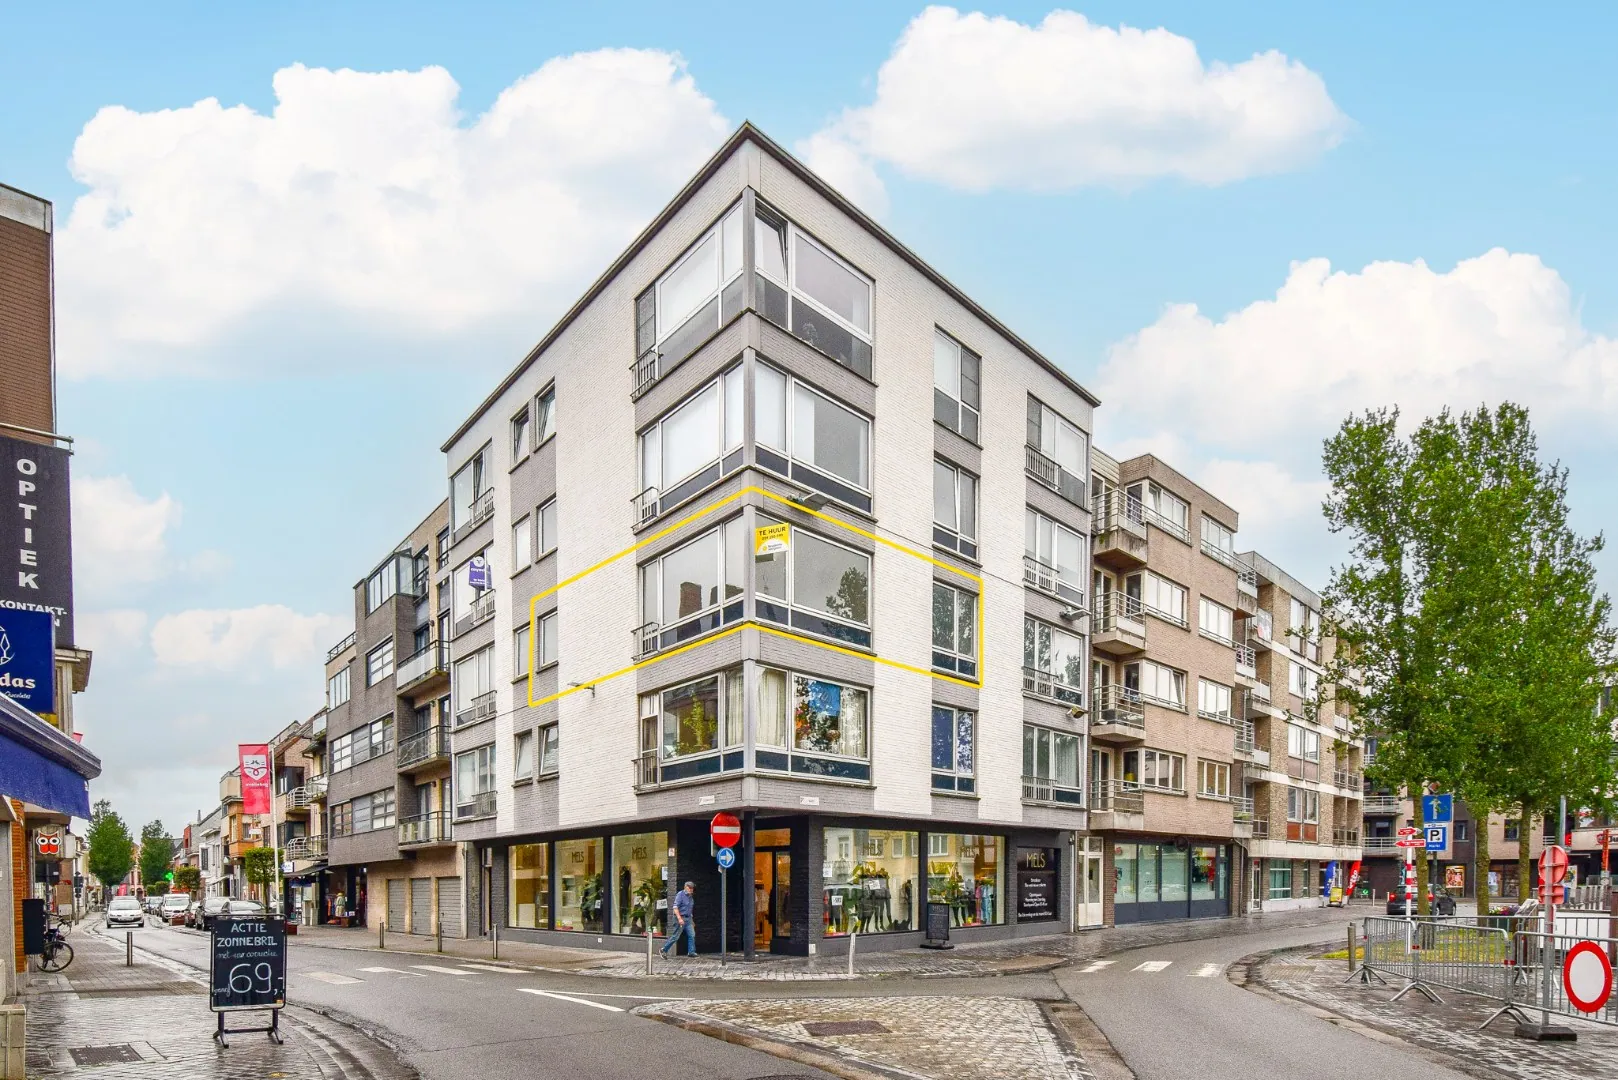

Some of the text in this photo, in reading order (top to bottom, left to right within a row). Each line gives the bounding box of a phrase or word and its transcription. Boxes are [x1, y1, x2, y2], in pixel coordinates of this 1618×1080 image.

[16, 458, 39, 589] OPTIEK
[0, 599, 67, 616] KONTAKT-
[631, 846, 648, 860] MELS
[1026, 852, 1046, 867] MELS
[231, 923, 267, 933] ACTIE
[217, 936, 277, 947] ZONNEBRIL
